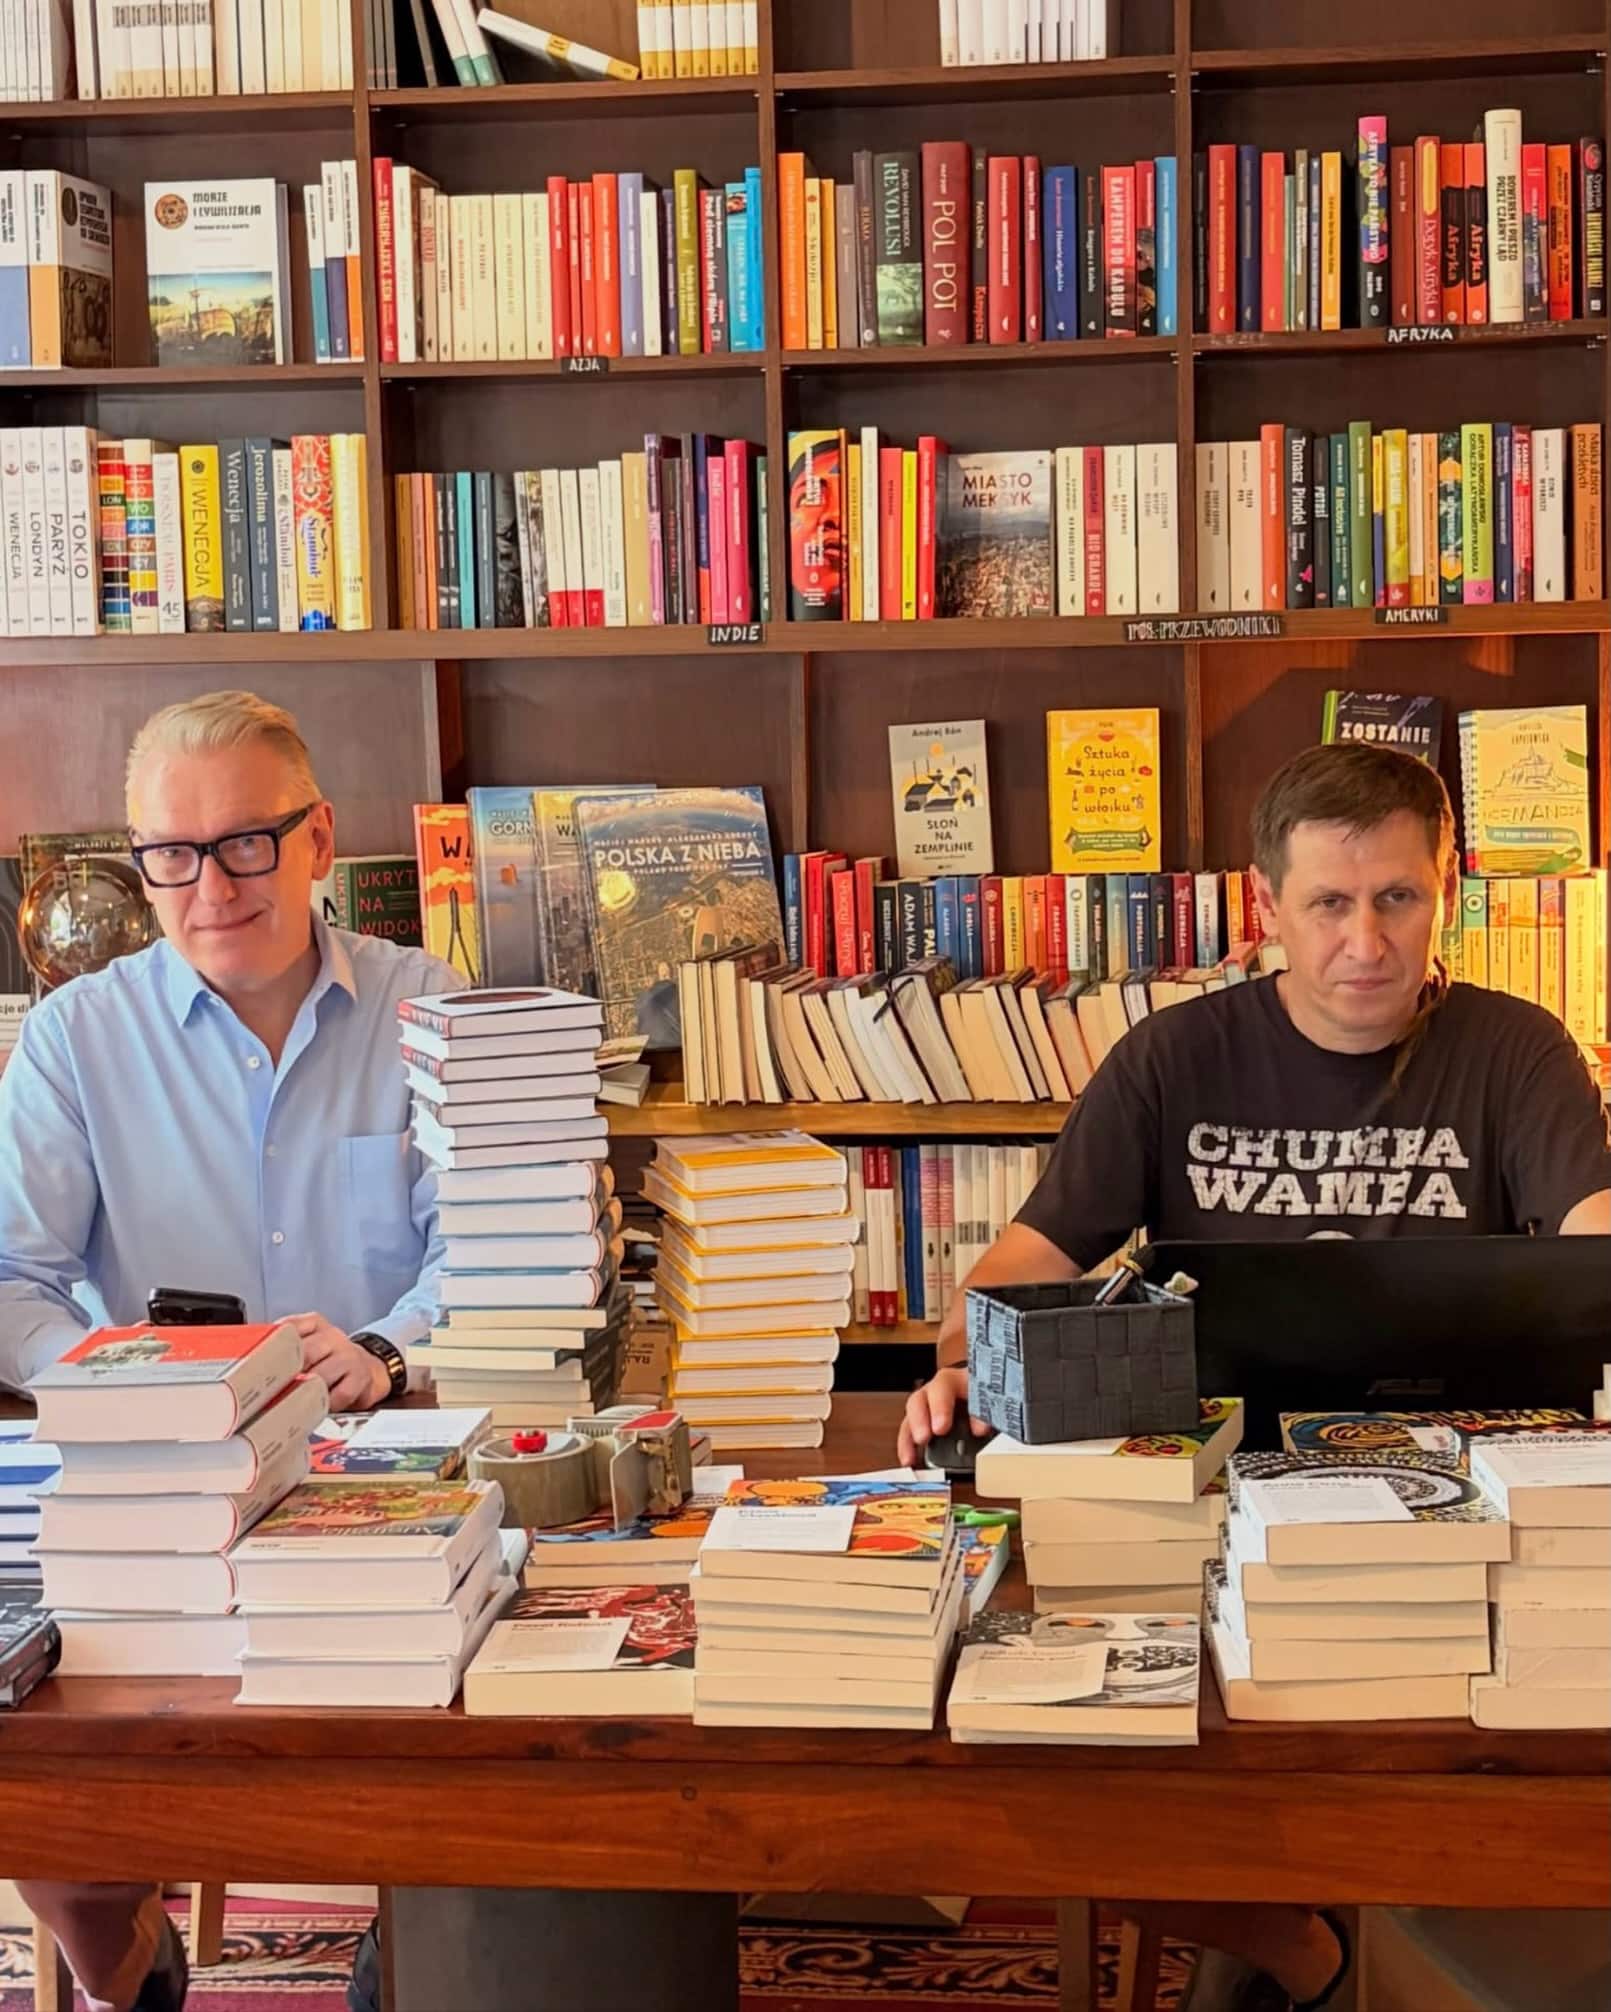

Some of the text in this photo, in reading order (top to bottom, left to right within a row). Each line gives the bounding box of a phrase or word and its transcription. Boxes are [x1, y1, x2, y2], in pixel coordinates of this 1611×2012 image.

[1367, 131, 1379, 172] AFRYKA
[883, 161, 901, 256] REVOLUSI
[932, 200, 957, 313] POL POT
[1446, 224, 1460, 281] Afryka
[1469, 224, 1484, 281] Afryka
[1111, 268, 1125, 317] KABULU
[1387, 329, 1454, 344] AFRYKA
[569, 358, 600, 372] AZJA
[224, 450, 244, 524] Wenecja
[251, 445, 268, 522] Jerozolima
[963, 472, 1032, 490] MIASTO
[963, 491, 1032, 508] MEKYK
[1291, 436, 1307, 526] Tomasz Pindel
[9, 512, 22, 580] WENECJA
[30, 512, 43, 577] LONDYN
[50, 513, 70, 576] PARYŻ
[72, 511, 89, 579] TOKIO
[192, 488, 210, 588] WENECJA
[711, 626, 760, 642] INDIE
[1385, 607, 1439, 623] AMERYKI
[1083, 746, 1130, 759] Sztuka
[1089, 766, 1125, 779] życia
[1099, 785, 1116, 796] po
[927, 817, 958, 830] SŁOŃ
[935, 831, 952, 841] NA
[594, 842, 761, 867] POLSKA Z NIEBA
[914, 842, 975, 854] ZEMPLINIE
[358, 869, 416, 888] UKRYT
[360, 897, 384, 913] NA
[904, 893, 915, 932] ADAM
[1187, 1121, 1470, 1170] CHUMBA
[1186, 1163, 1468, 1219] WAMBA
